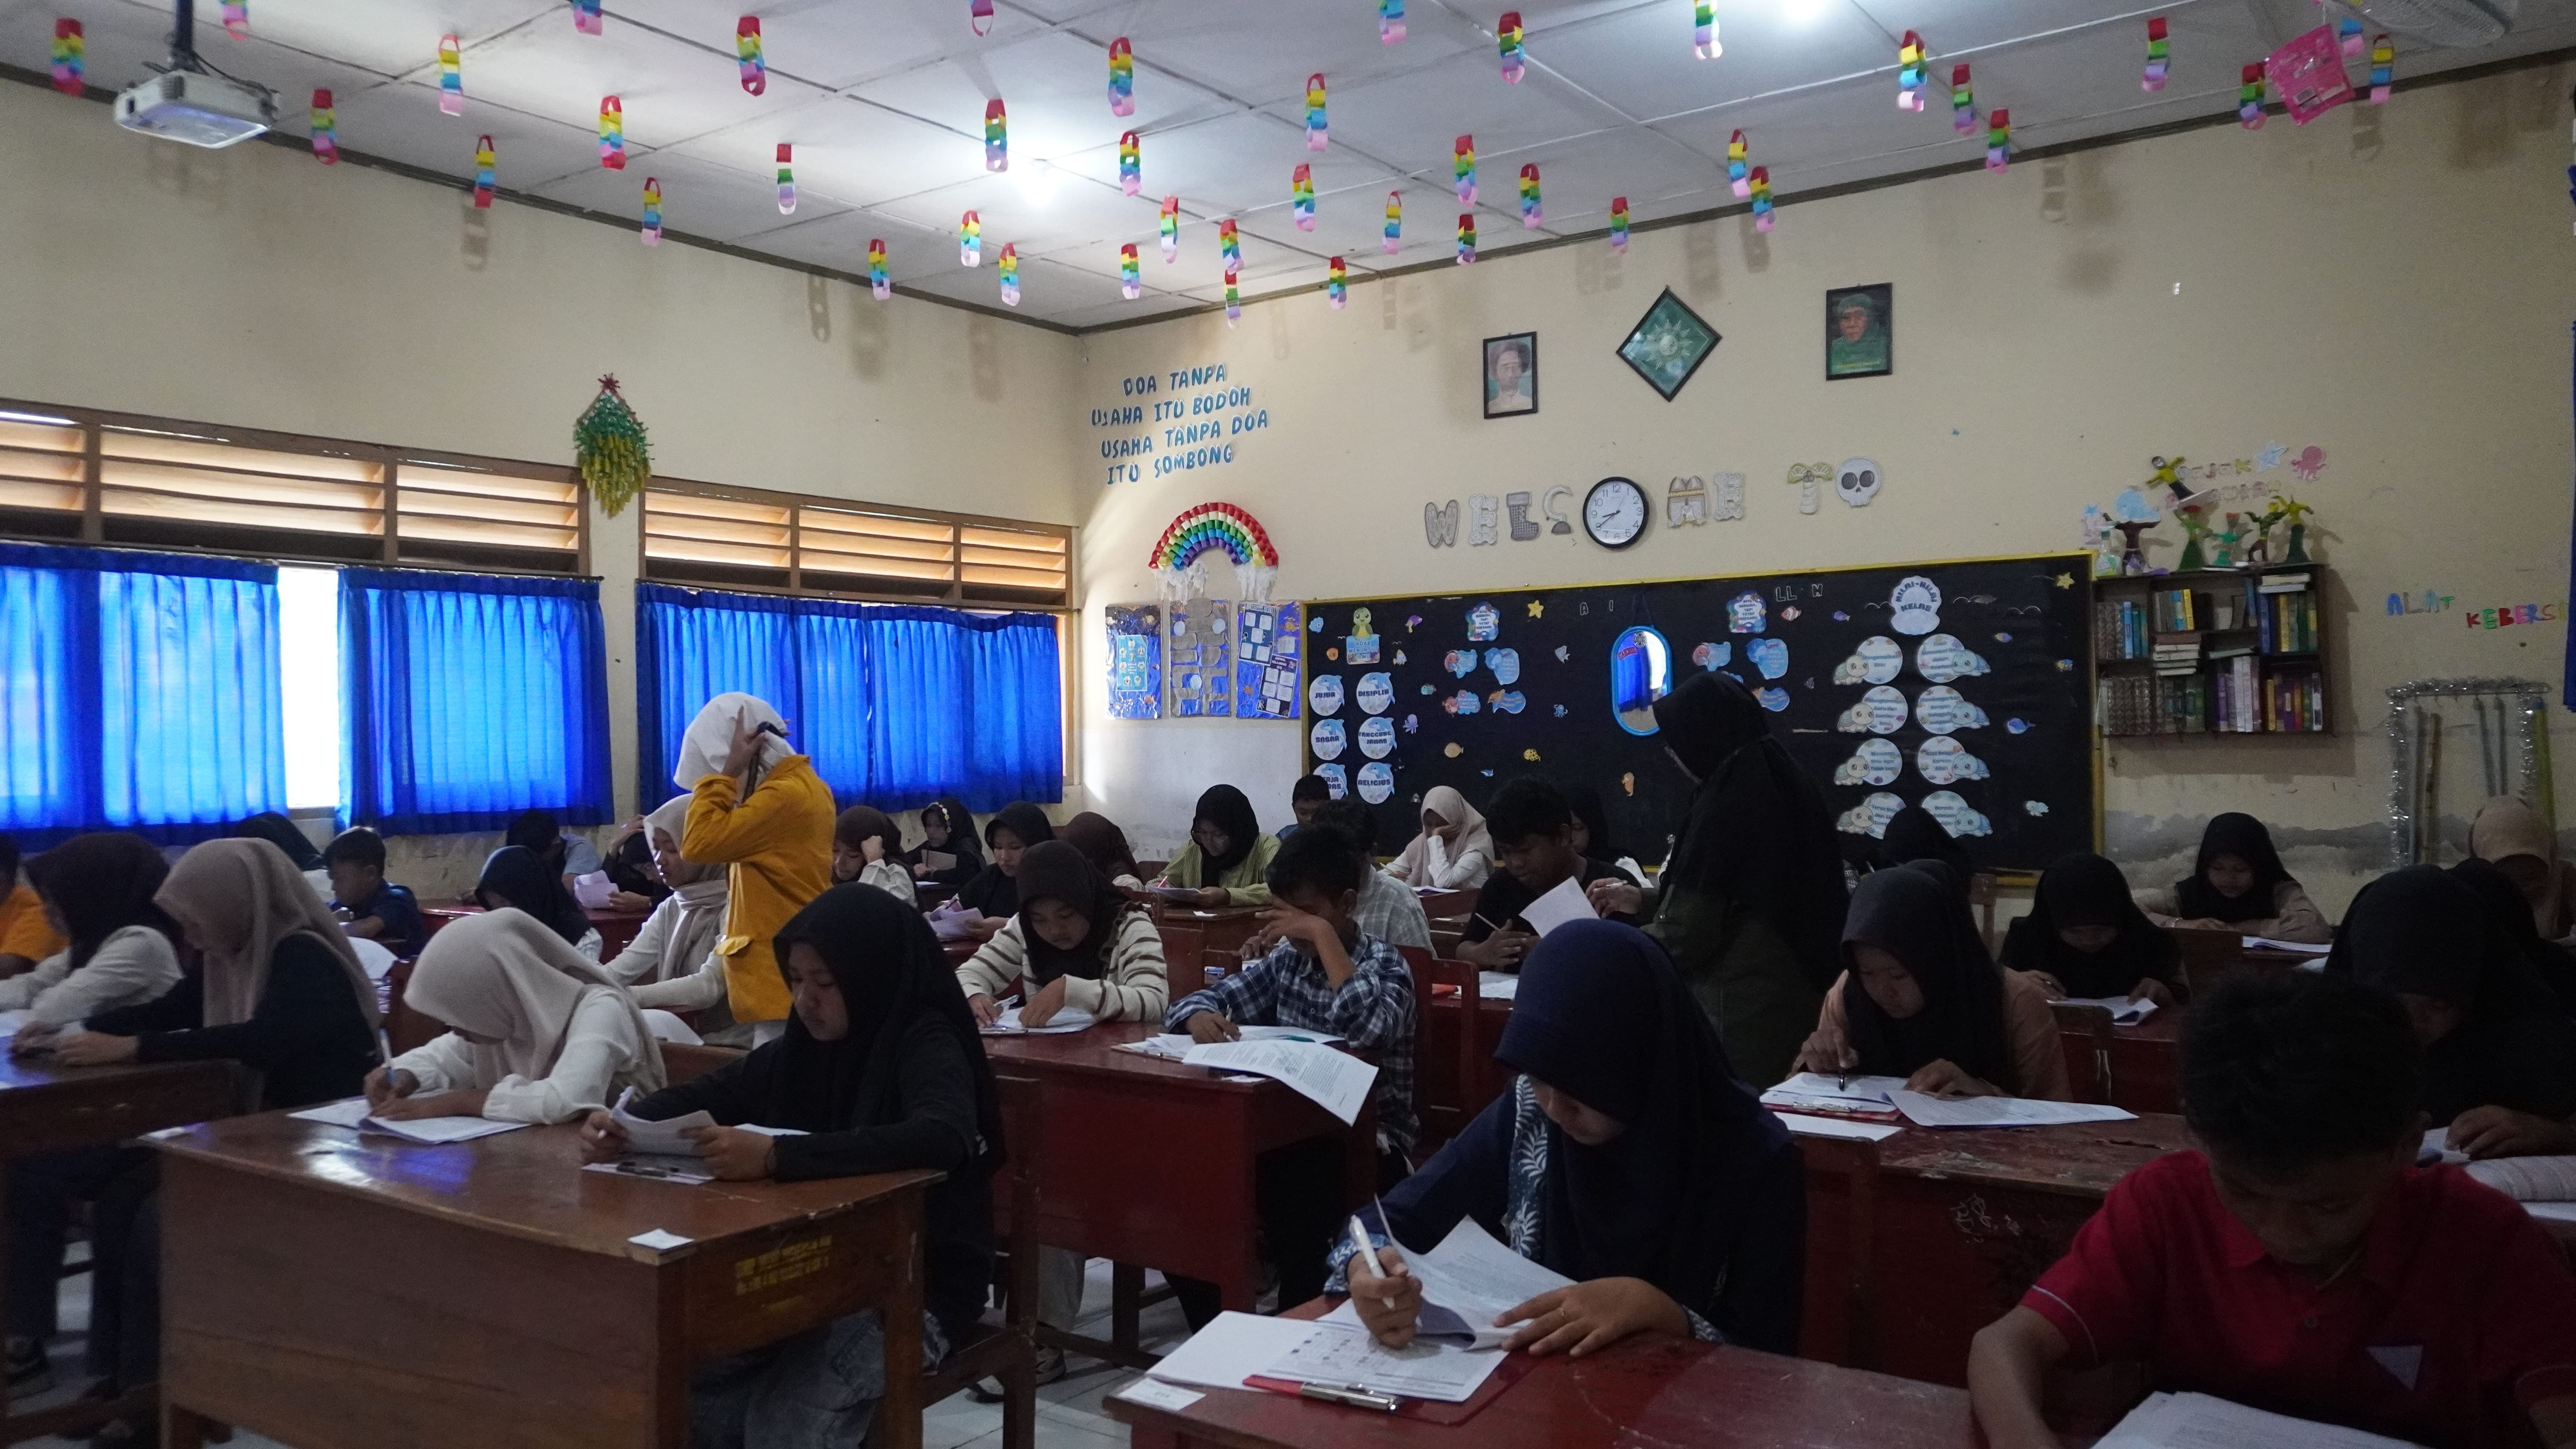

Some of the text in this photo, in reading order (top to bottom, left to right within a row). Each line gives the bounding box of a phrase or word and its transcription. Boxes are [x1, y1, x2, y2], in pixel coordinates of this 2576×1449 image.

[1123, 364, 1226, 397] DOA TANPA
[1091, 387, 1251, 426] USAHA ITU BODOH
[1101, 409, 1268, 458] USAHA TANPA DOA
[1107, 443, 1233, 485] ITU SOMBONG
[1896, 581, 1938, 603] NILAI-NILAI
[2387, 589, 2455, 615] ALAT
[1901, 603, 1932, 612] KELAS
[1358, 688, 1390, 697] DISIPLIN
